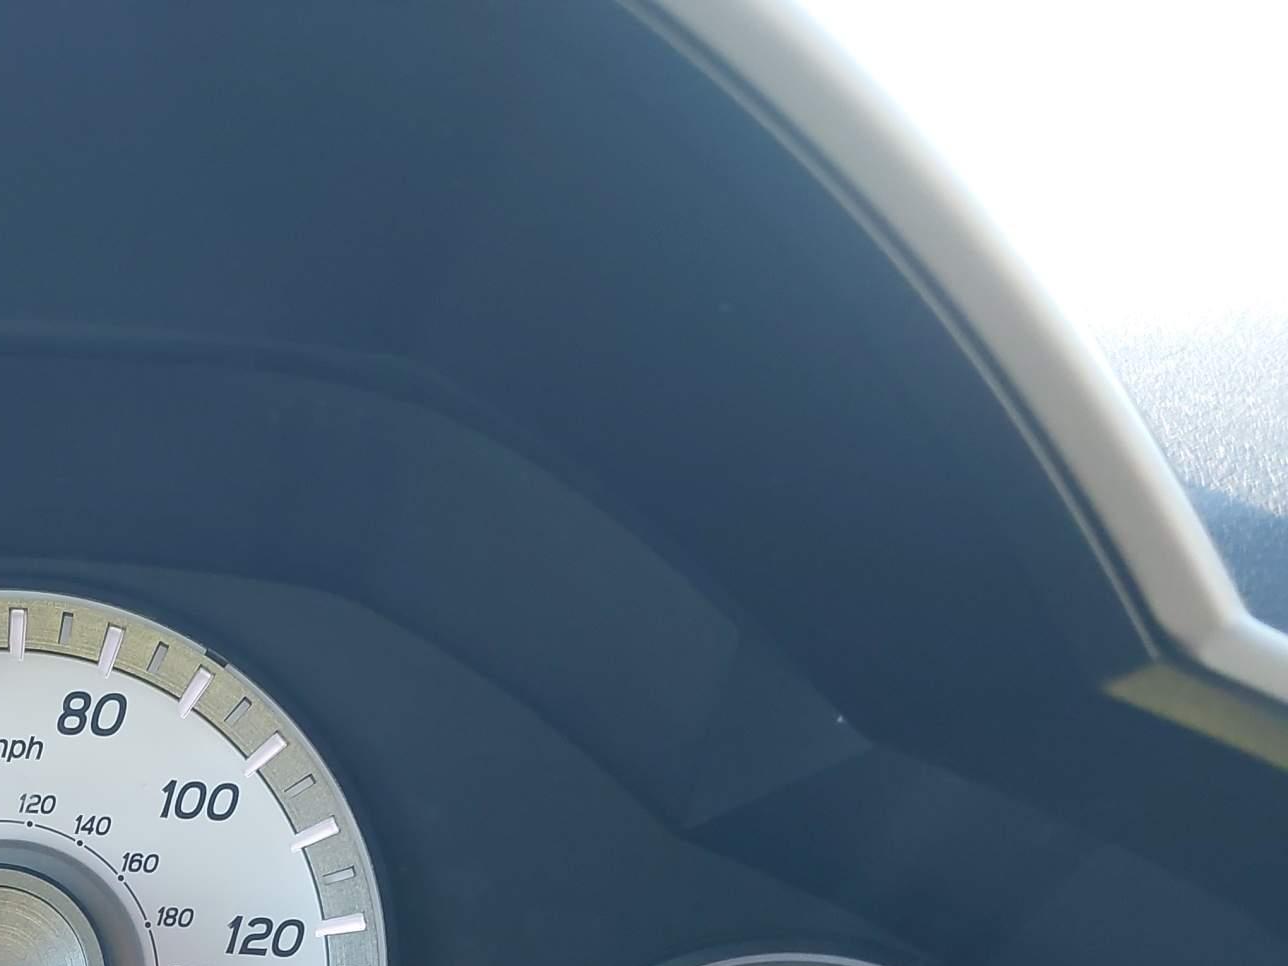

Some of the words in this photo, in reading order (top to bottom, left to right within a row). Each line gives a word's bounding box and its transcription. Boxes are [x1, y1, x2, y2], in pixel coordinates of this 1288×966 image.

[57, 690, 127, 737] 80
[18, 792, 57, 815] 120
[160, 780, 239, 822] 100
[74, 814, 112, 836] 140
[121, 852, 159, 874] 160
[157, 907, 194, 929] 180
[225, 916, 305, 958] 120
